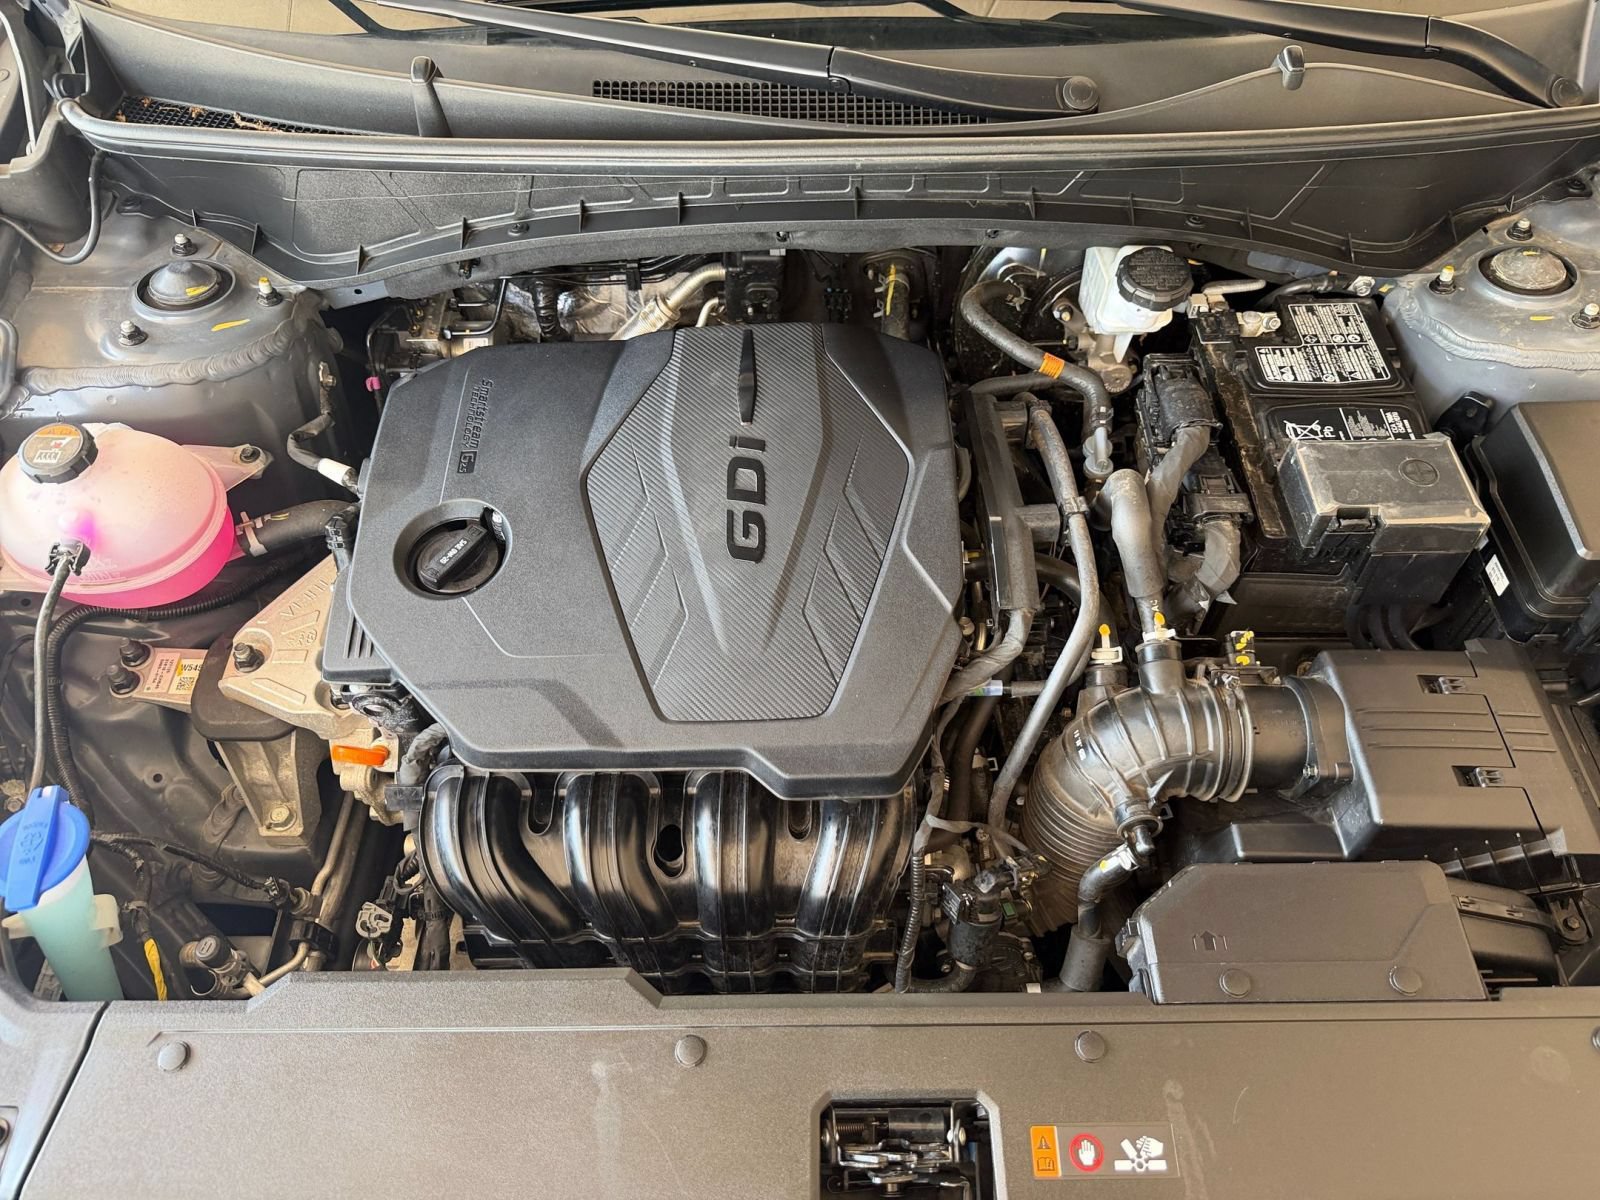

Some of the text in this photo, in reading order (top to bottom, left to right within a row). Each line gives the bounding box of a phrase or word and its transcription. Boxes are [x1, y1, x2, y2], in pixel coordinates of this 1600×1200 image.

[462, 386, 480, 448] TECHNOLOGY
[469, 378, 493, 449] Smartstream
[1323, 425, 1336, 438] Pb
[726, 435, 766, 564] GDi
[440, 539, 467, 565] SAE 0W-20
